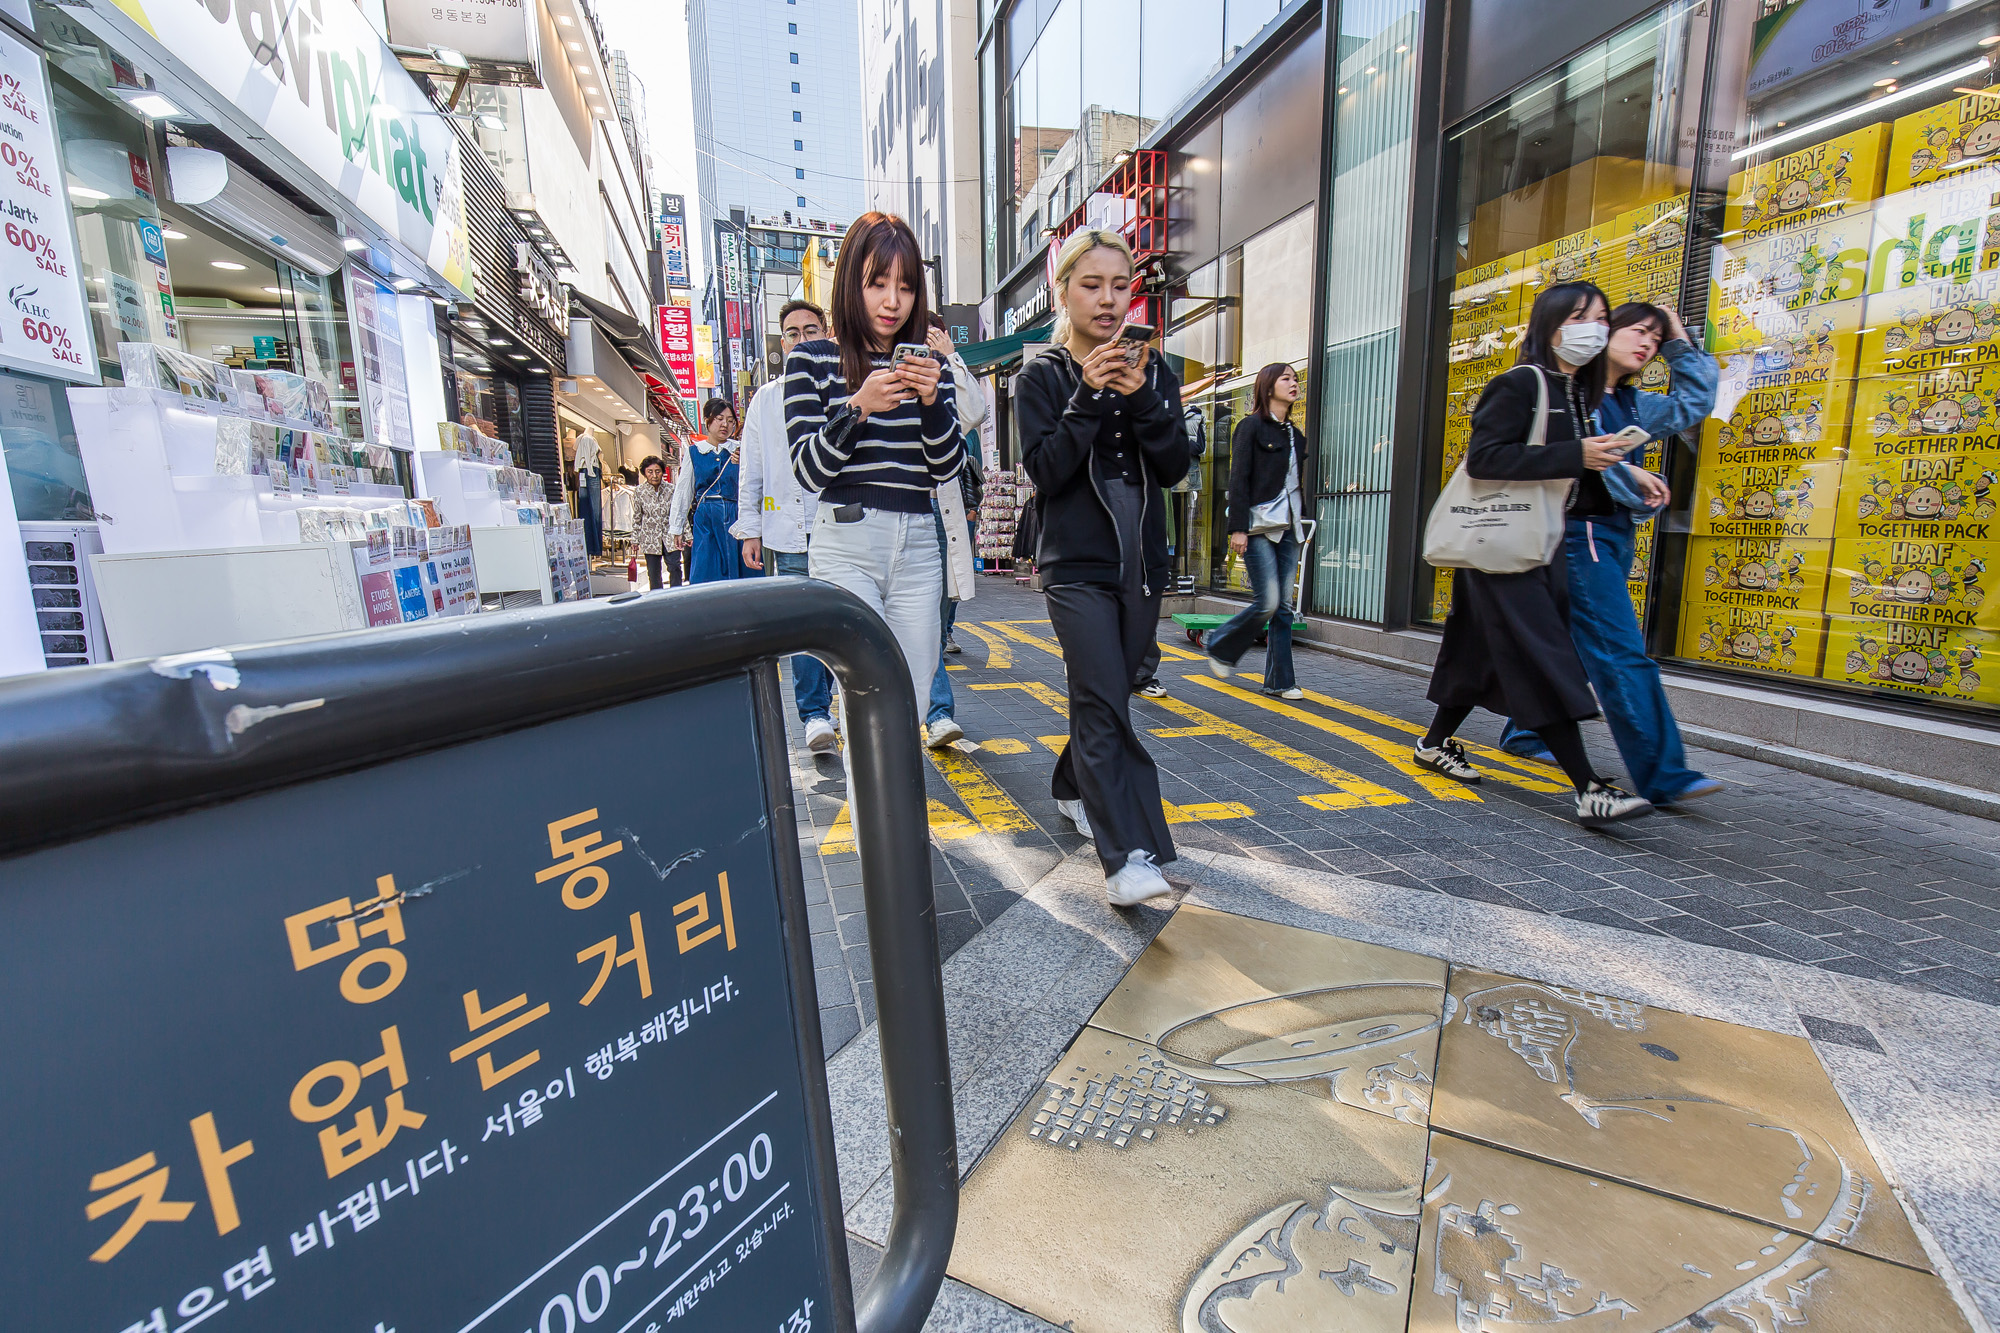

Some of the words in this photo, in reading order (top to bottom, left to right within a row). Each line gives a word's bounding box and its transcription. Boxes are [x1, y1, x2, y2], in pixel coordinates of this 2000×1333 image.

[2, 94, 39, 124] SALE
[1959, 92, 2000, 124] HBA
[1775, 144, 1827, 182] HBAF
[16, 171, 52, 198] SALE
[666, 197, 680, 213] 방
[1741, 213, 1807, 243] TOGETHER
[1810, 200, 1847, 221] PACK
[5, 222, 56, 260] 60%
[727, 234, 735, 262] HALAL
[1554, 231, 1586, 258] HBAF
[1768, 228, 1818, 262] HBAF
[36, 257, 68, 278] SALE
[1473, 261, 1498, 284] HBAF
[1626, 251, 1680, 276] TOGETHER
[113, 281, 136, 296] umbrella
[729, 266, 737, 291] FOOD
[1930, 272, 1998, 310] HBAF
[673, 299, 691, 307] ACE
[1803, 285, 1839, 307] PACK
[21, 301, 50, 320] A.H.C
[1456, 306, 1489, 324] TOGETHER
[1490, 301, 1508, 315] PACK
[23, 317, 71, 349] 60%
[664, 309, 689, 350] 은행골
[1469, 318, 1494, 338] HBAF
[1761, 310, 1810, 338] HBAF
[52, 347, 83, 365] SALE
[1452, 361, 1484, 377] TOGETHER
[1485, 357, 1504, 370] PACK
[1884, 347, 1973, 373] TOGETHER
[1976, 344, 2000, 363] PA
[672, 367, 690, 375] ushi
[1464, 373, 1489, 392] HBAF
[1728, 371, 1791, 393] TOGETHER
[1796, 367, 1830, 385] PACK
[1918, 365, 1985, 397] HBAF
[1750, 388, 1798, 414] HBAF
[1718, 448, 1781, 465] TOGETHER
[1784, 446, 1817, 461] PACK
[1874, 437, 1957, 457] TOGETHER
[1741, 464, 1790, 487] HBAF
[1901, 455, 1966, 483] HBAF
[1710, 522, 1772, 536] TOGETHER
[1775, 522, 1810, 536] PACK
[1858, 522, 1946, 539] TOGETHER
[1949, 523, 1991, 539] PACK
[1735, 538, 1782, 559] HBAF
[1891, 541, 1953, 566] HBAF
[370, 588, 391, 602] ETUDE
[373, 601, 394, 614] HOUSE
[1704, 589, 1764, 607] TOGETHER
[1766, 594, 1800, 610] PACK
[1728, 607, 1774, 630] HBAF
[1849, 601, 1929, 623] TOGETHER
[1934, 607, 1979, 626] PACK
[1886, 622, 1949, 649] HBAF
[481, 1067, 577, 1144] 서울이
[584, 975, 741, 1082] 행복해집니다.
[665, 1257, 732, 1323] 제한하고
[735, 1201, 795, 1264] 있습니다.
